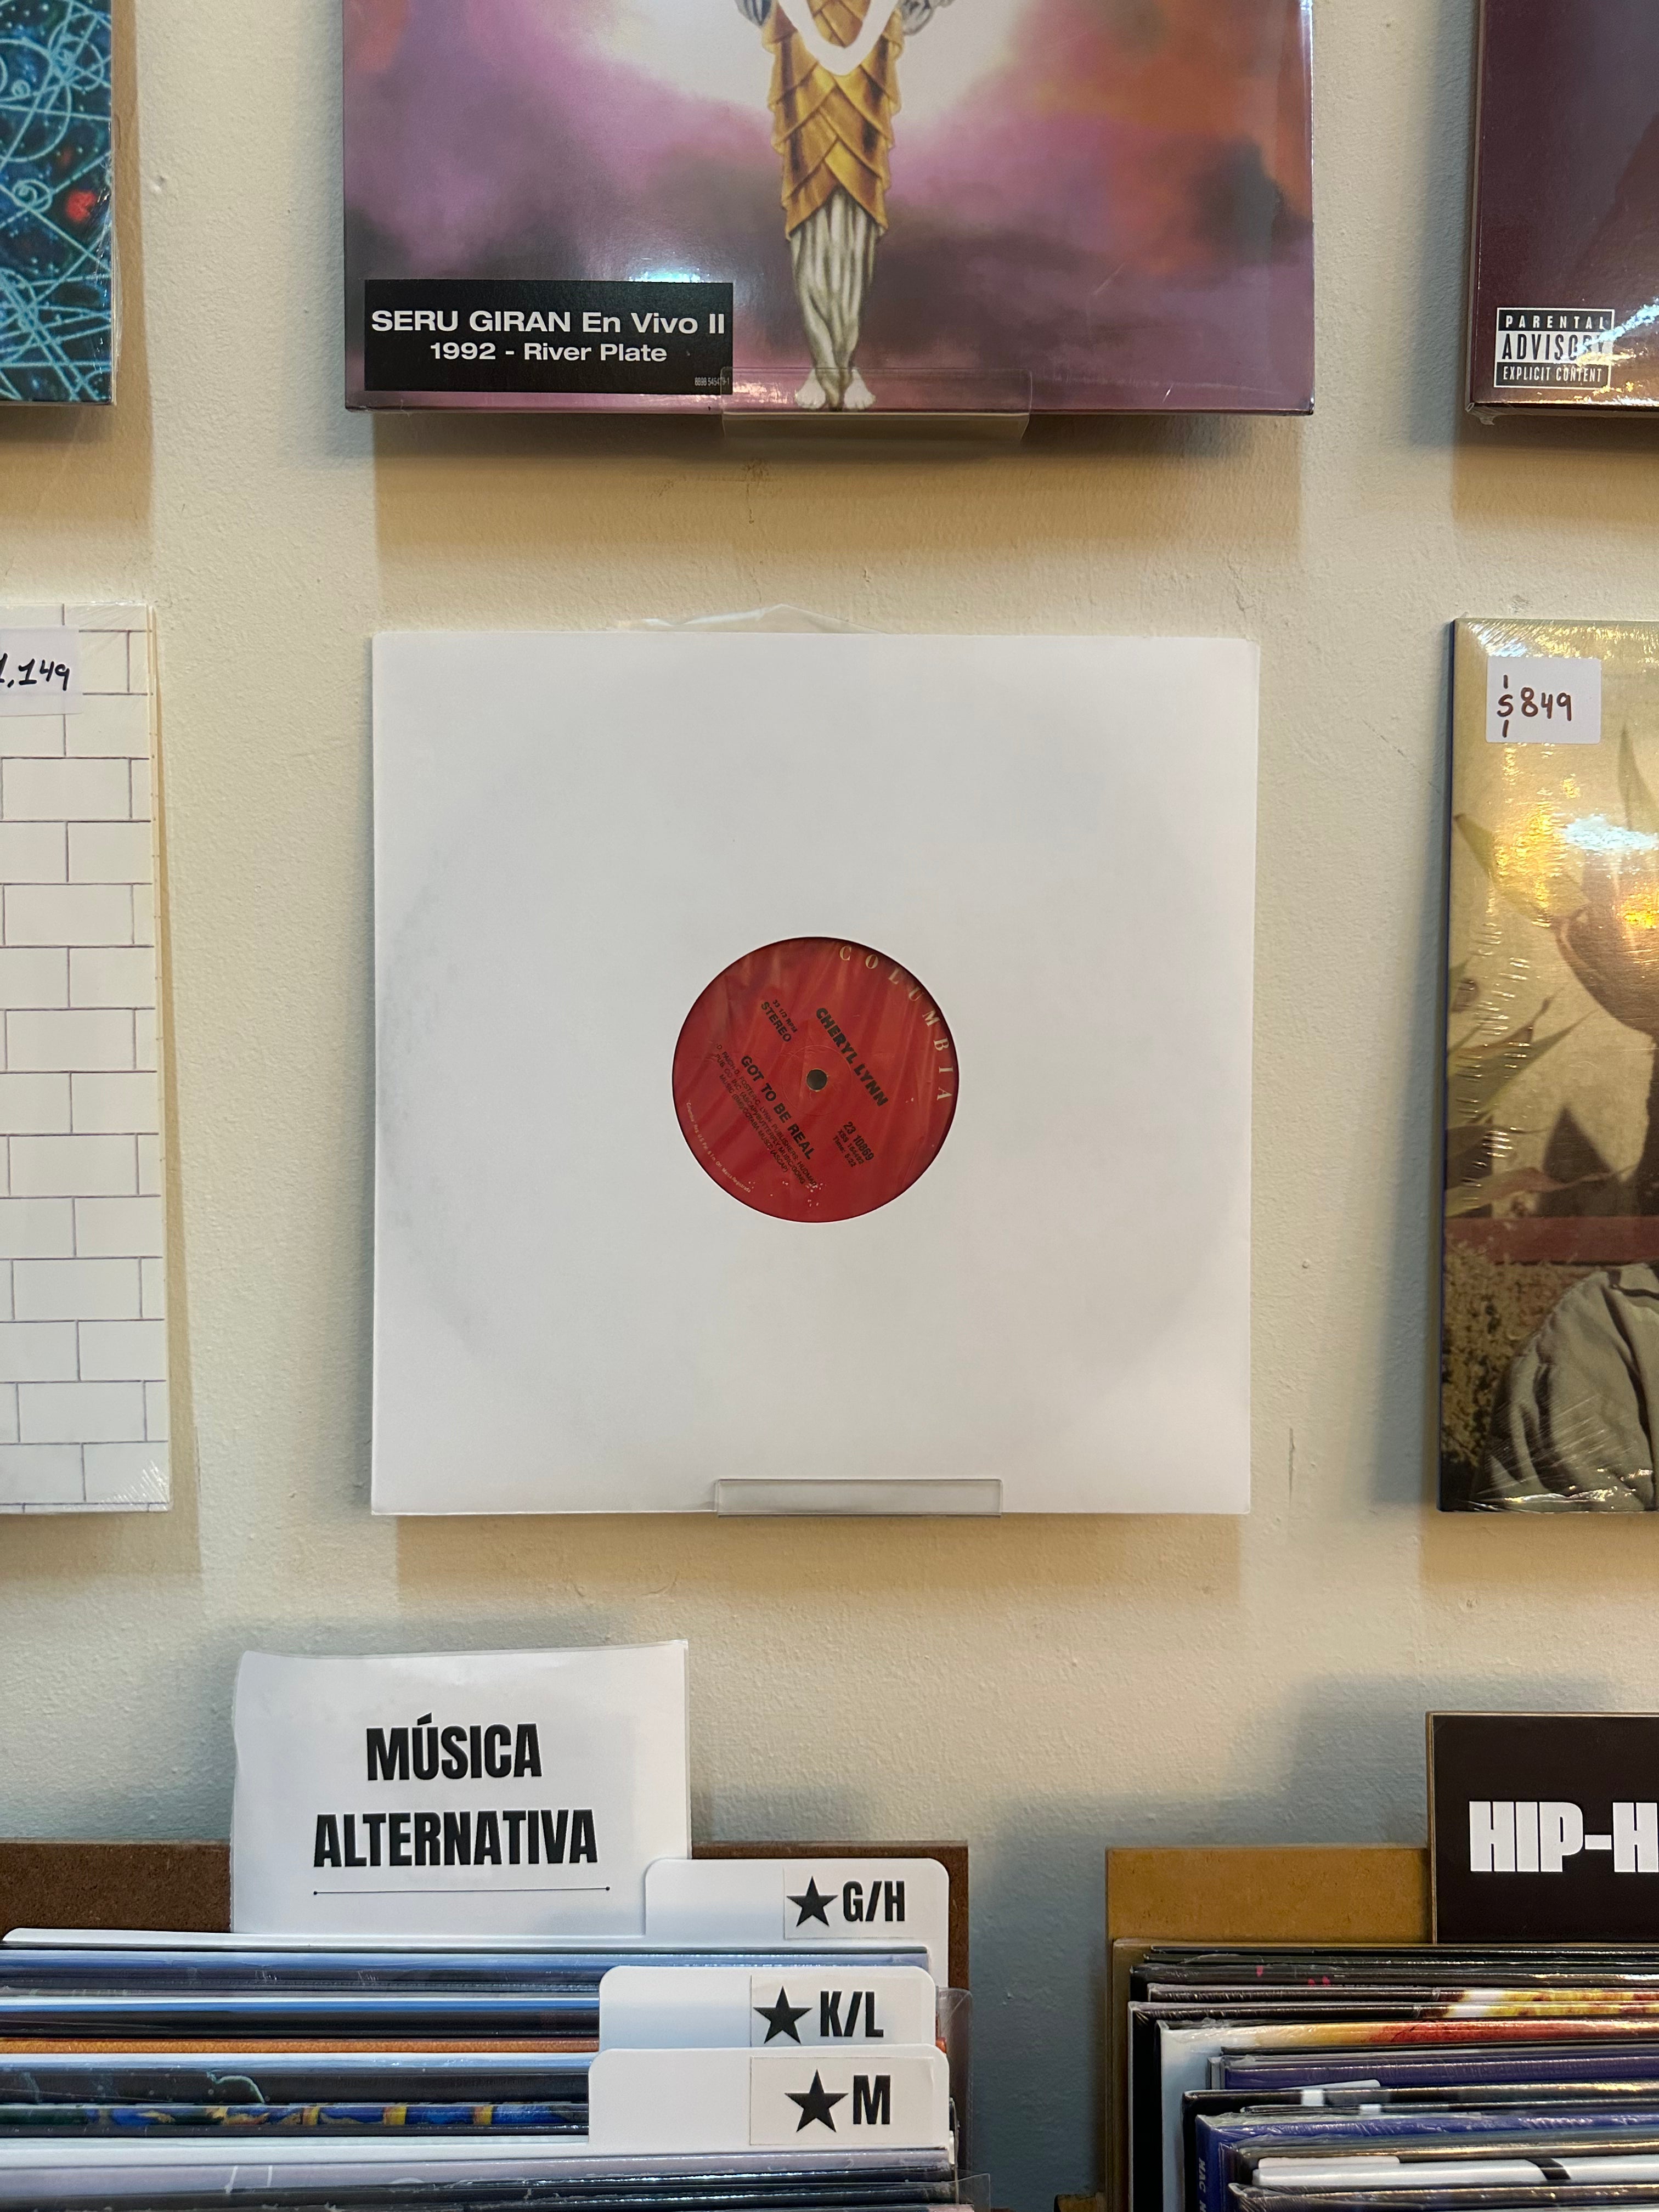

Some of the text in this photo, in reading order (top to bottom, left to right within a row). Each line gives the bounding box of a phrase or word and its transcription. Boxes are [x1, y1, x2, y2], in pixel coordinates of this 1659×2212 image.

[371, 311, 725, 334] SERU GIRAN En Vivo II
[1505, 315, 1605, 329] PARENTAL
[430, 343, 495, 359] 1992
[524, 343, 591, 361] River
[600, 344, 667, 362] Plate
[1503, 366, 1602, 382] EXPLICIT CONTENT
[1497, 675, 1572, 738] $849
[761, 1001, 792, 1042] STEREO
[772, 998, 798, 1033] 33 1/3 RPM
[839, 945, 954, 1101] COLUMBIA
[816, 1007, 888, 1107] CHERYL LYNN
[718, 1074, 734, 1094] MUSIC
[757, 1130, 773, 1150] MUSIC
[769, 1148, 788, 1173] (ASCAP)
[741, 1055, 815, 1160] GOT TO BE REAL
[842, 1120, 875, 1161] 23 10869
[366, 1712, 542, 1781] MÚSICA
[314, 1809, 599, 1867] ALTERNATIVA
[1469, 1801, 1659, 1873] HIP-H
[843, 1880, 905, 1922] G/H
[820, 1991, 884, 2038] K/L
[853, 2075, 891, 2125] M
